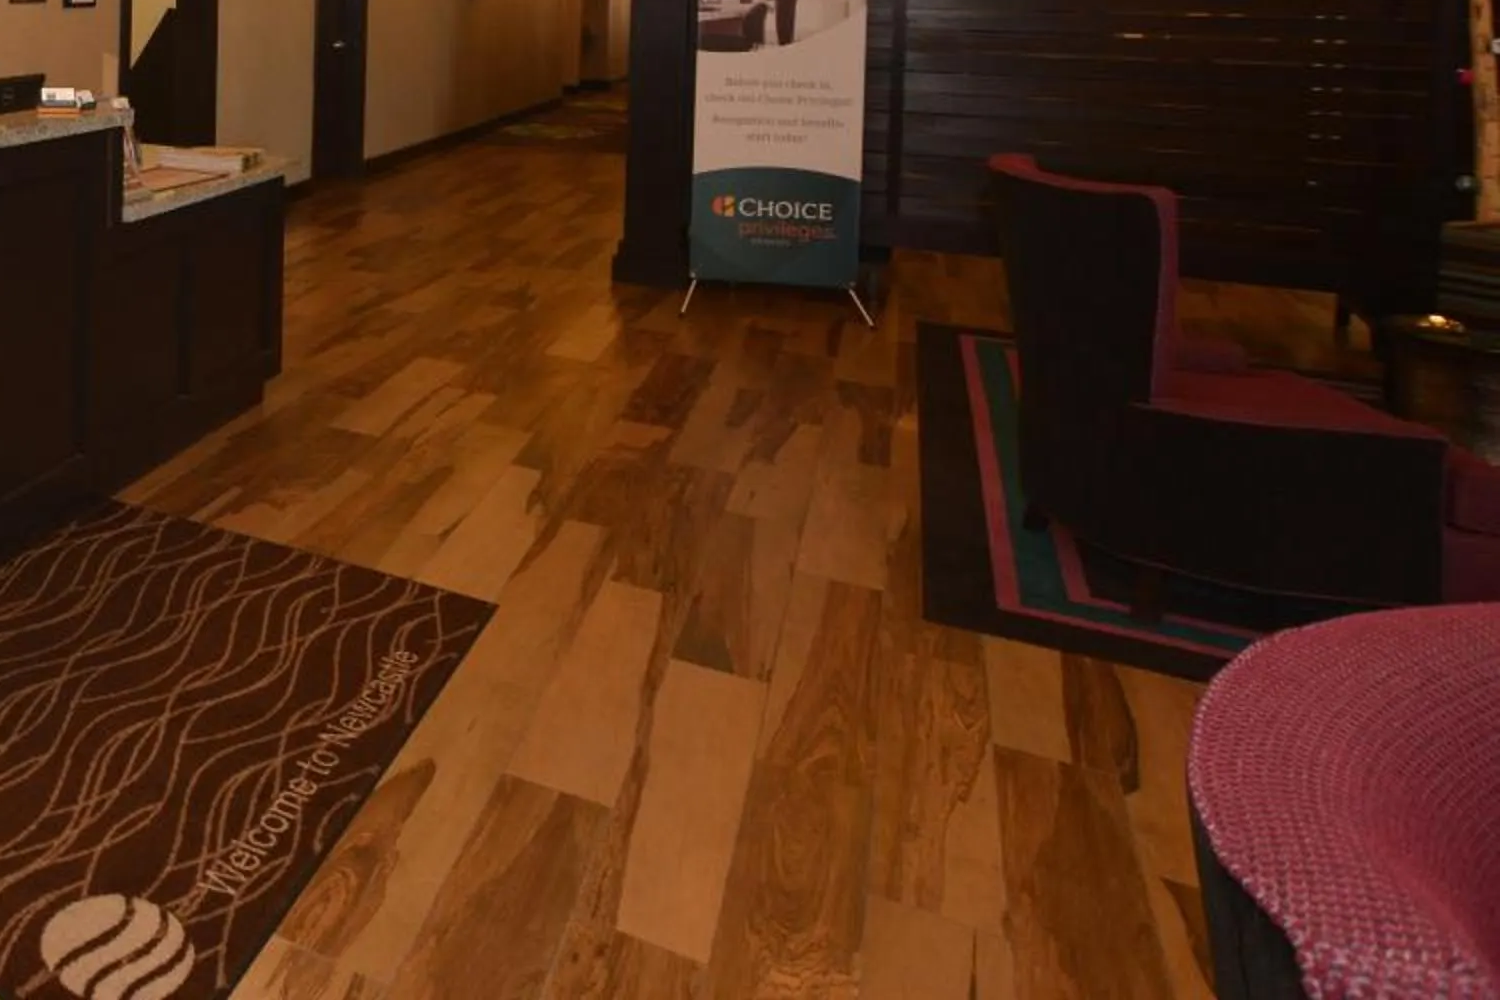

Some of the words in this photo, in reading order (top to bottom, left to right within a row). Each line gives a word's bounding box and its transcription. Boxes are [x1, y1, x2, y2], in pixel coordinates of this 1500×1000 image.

[737, 196, 833, 221] CHOICE
[317, 650, 419, 748] Newcastle
[297, 748, 341, 776] to
[198, 774, 317, 896] Welcome
